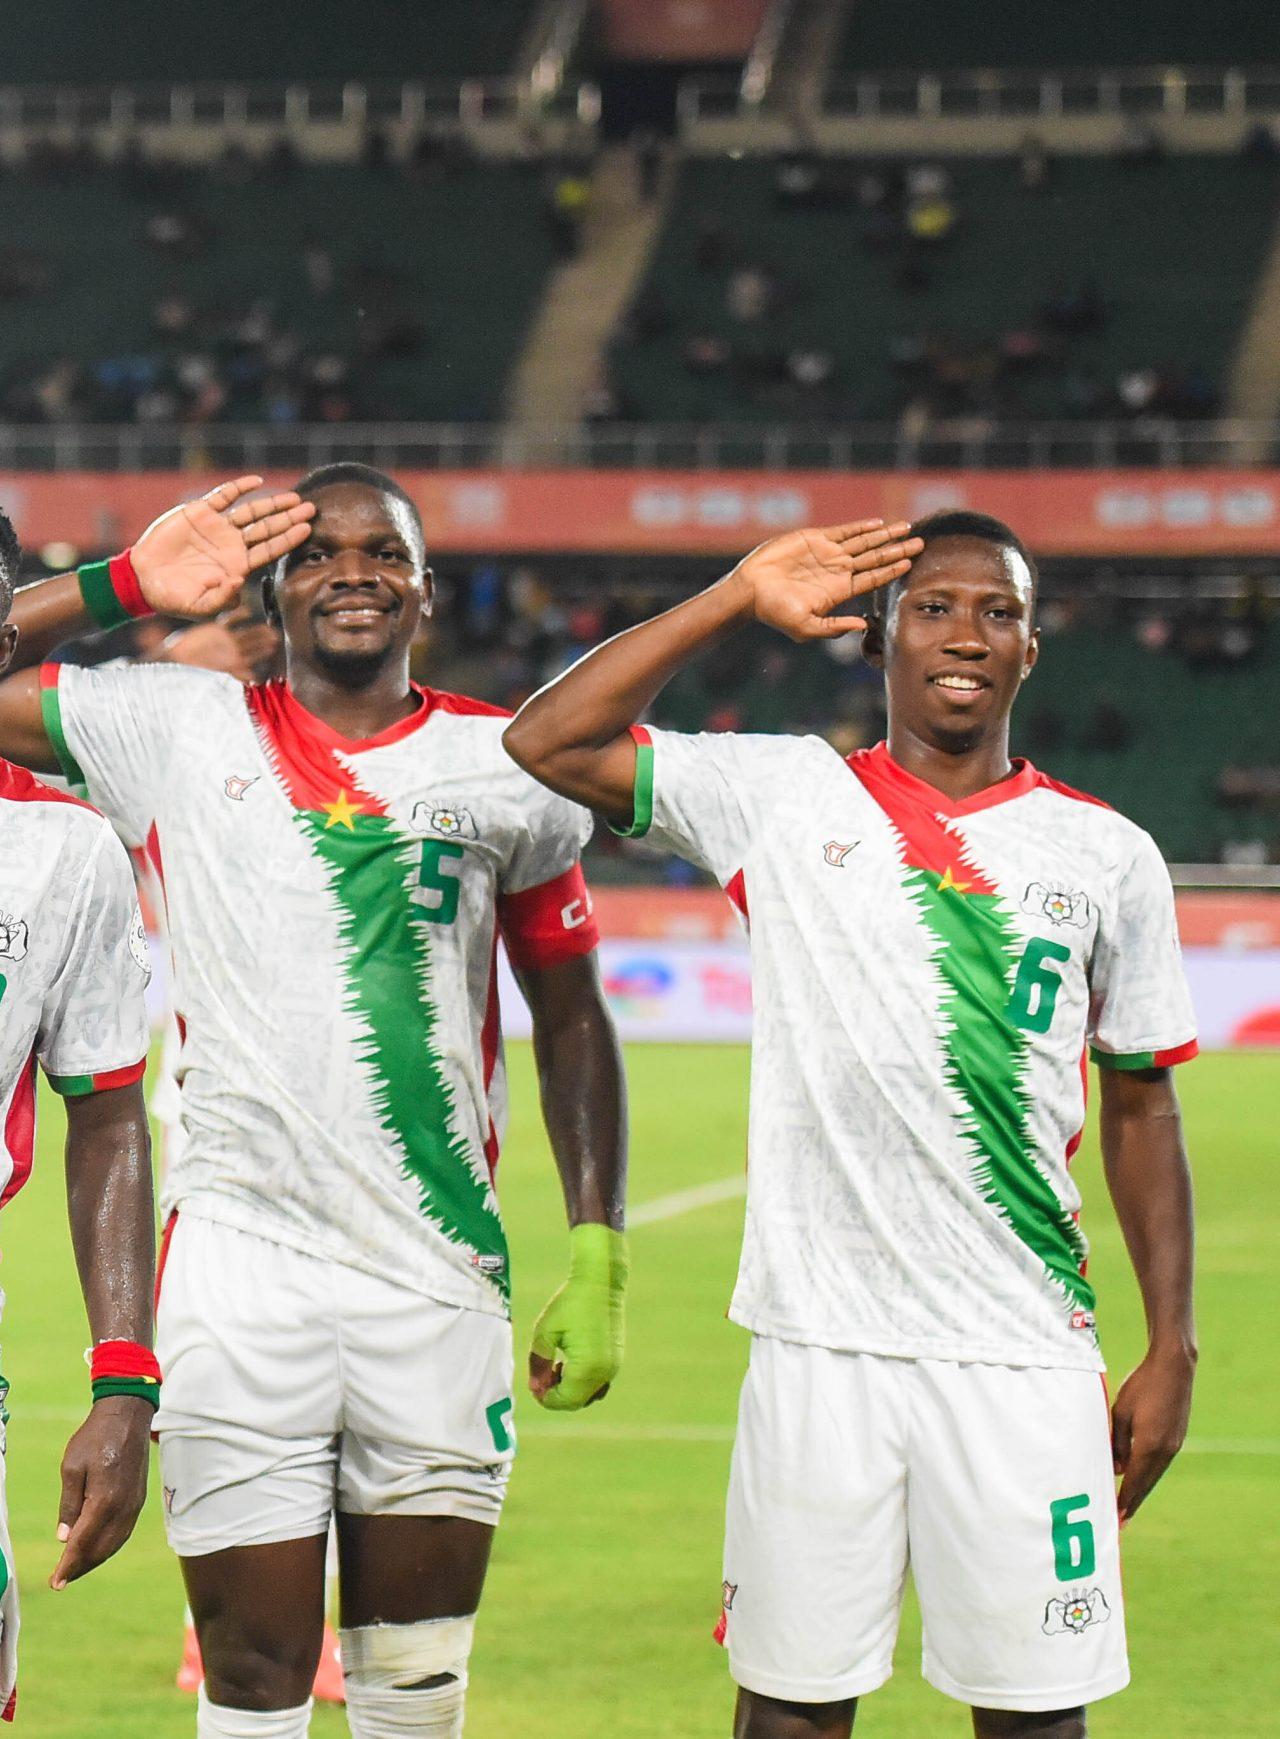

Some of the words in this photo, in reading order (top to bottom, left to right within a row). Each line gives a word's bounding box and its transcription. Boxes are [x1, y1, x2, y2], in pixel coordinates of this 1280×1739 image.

[410, 839, 464, 925] 5
[1009, 937, 1071, 1034] 6
[1050, 1494, 1095, 1582] 6
